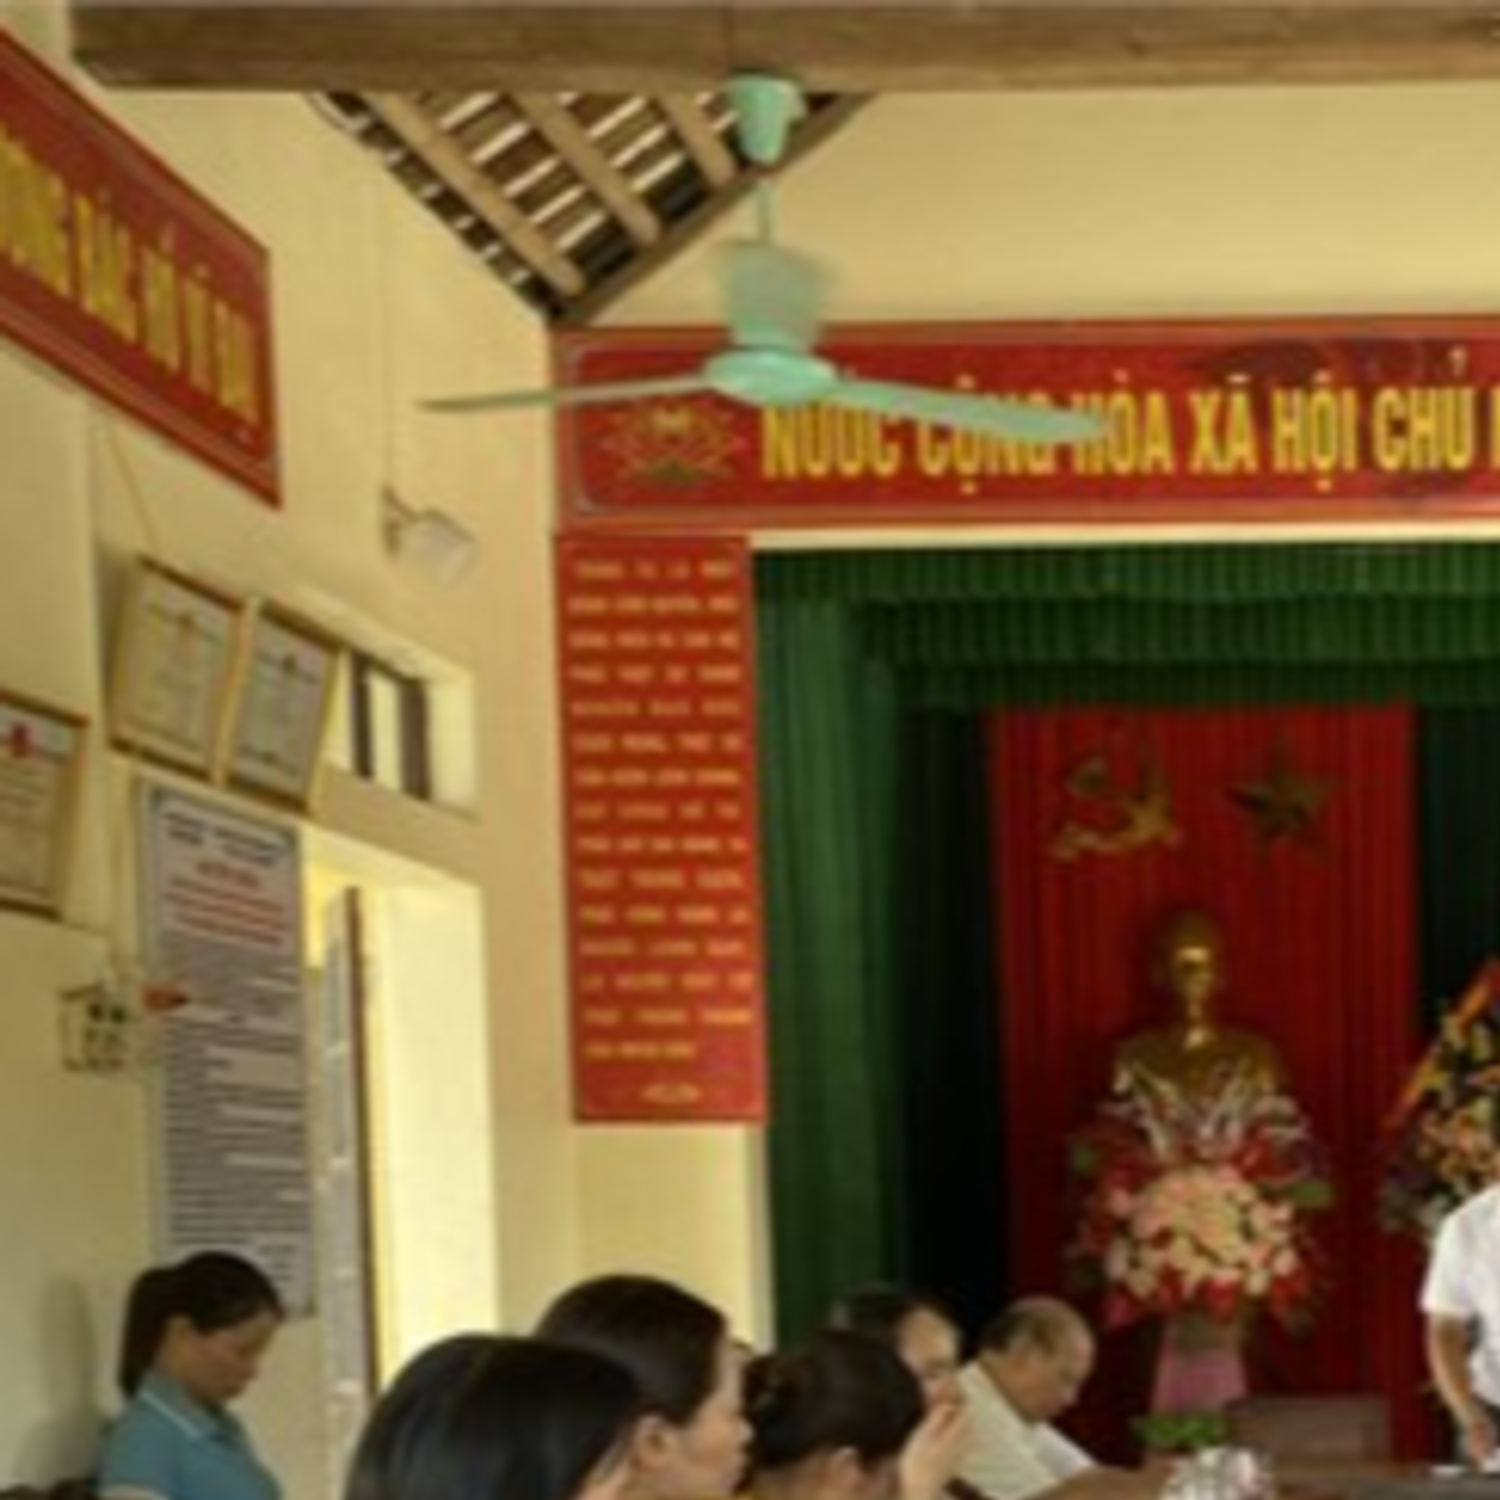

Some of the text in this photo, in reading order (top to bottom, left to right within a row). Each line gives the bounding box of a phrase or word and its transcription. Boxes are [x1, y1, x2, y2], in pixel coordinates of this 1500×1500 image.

[1071, 369, 1175, 476] HÒA
[1188, 374, 1260, 474] XÃ
[1273, 370, 1357, 492] HỘI
[1371, 348, 1476, 472] CHỦ
